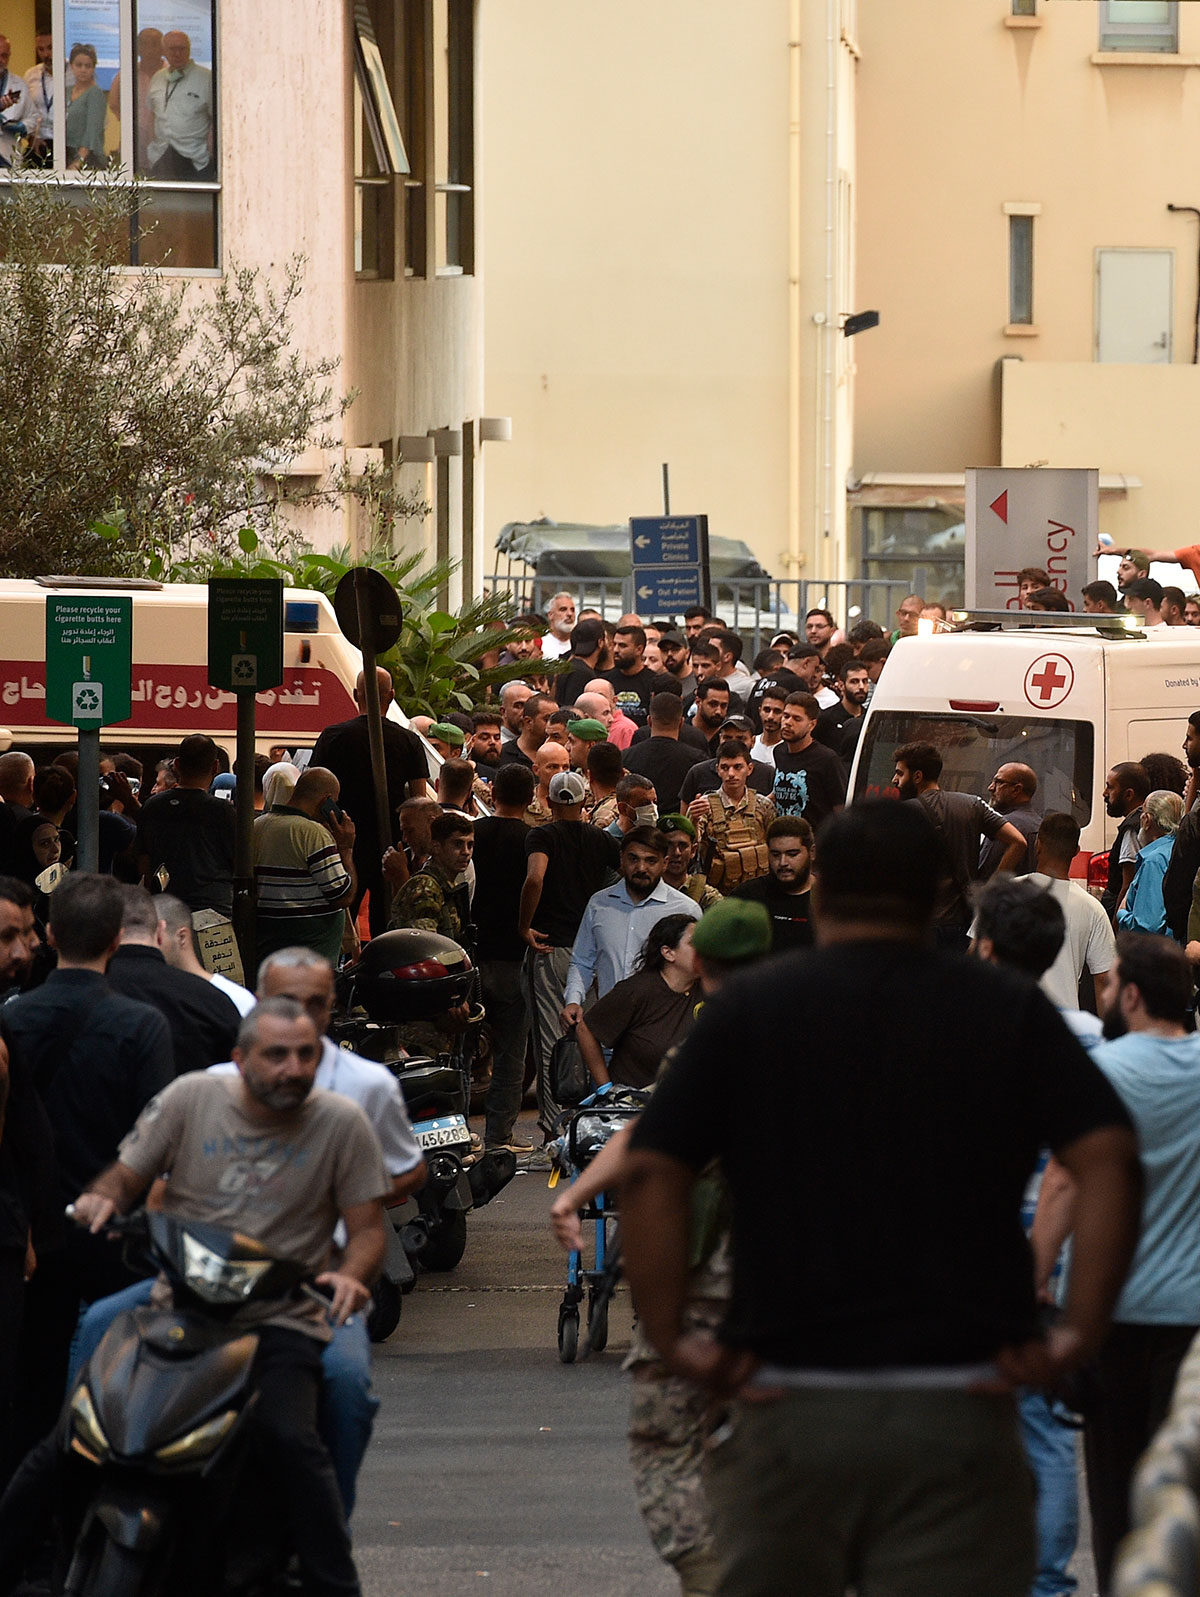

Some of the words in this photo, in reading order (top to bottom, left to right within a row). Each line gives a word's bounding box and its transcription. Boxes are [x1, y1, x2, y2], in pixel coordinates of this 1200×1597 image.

[661, 542, 690, 550] Private
[662, 552, 690, 561] Clinics
[657, 588, 670, 597] Out
[672, 587, 698, 596] Patient
[657, 598, 698, 608] Department
[55, 605, 79, 614] Please
[79, 605, 104, 615] recycle
[105, 607, 121, 615] your
[55, 615, 86, 624] cigarette
[86, 615, 105, 623] butts
[62, 628, 79, 636] تدوير
[80, 628, 96, 636] إعادة
[97, 628, 114, 636] الرجاء
[72, 636, 96, 645] السجائر
[97, 636, 116, 644] أعقاب
[1164, 679, 1190, 688] Donated
[1191, 678, 1199, 687] by
[2, 676, 46, 705] حاج
[255, 680, 322, 707] تقدم
[155, 684, 203, 709] روح
[204, 686, 238, 710] ن
[204, 934, 234, 949] الصدقة
[212, 948, 233, 963] تدفع
